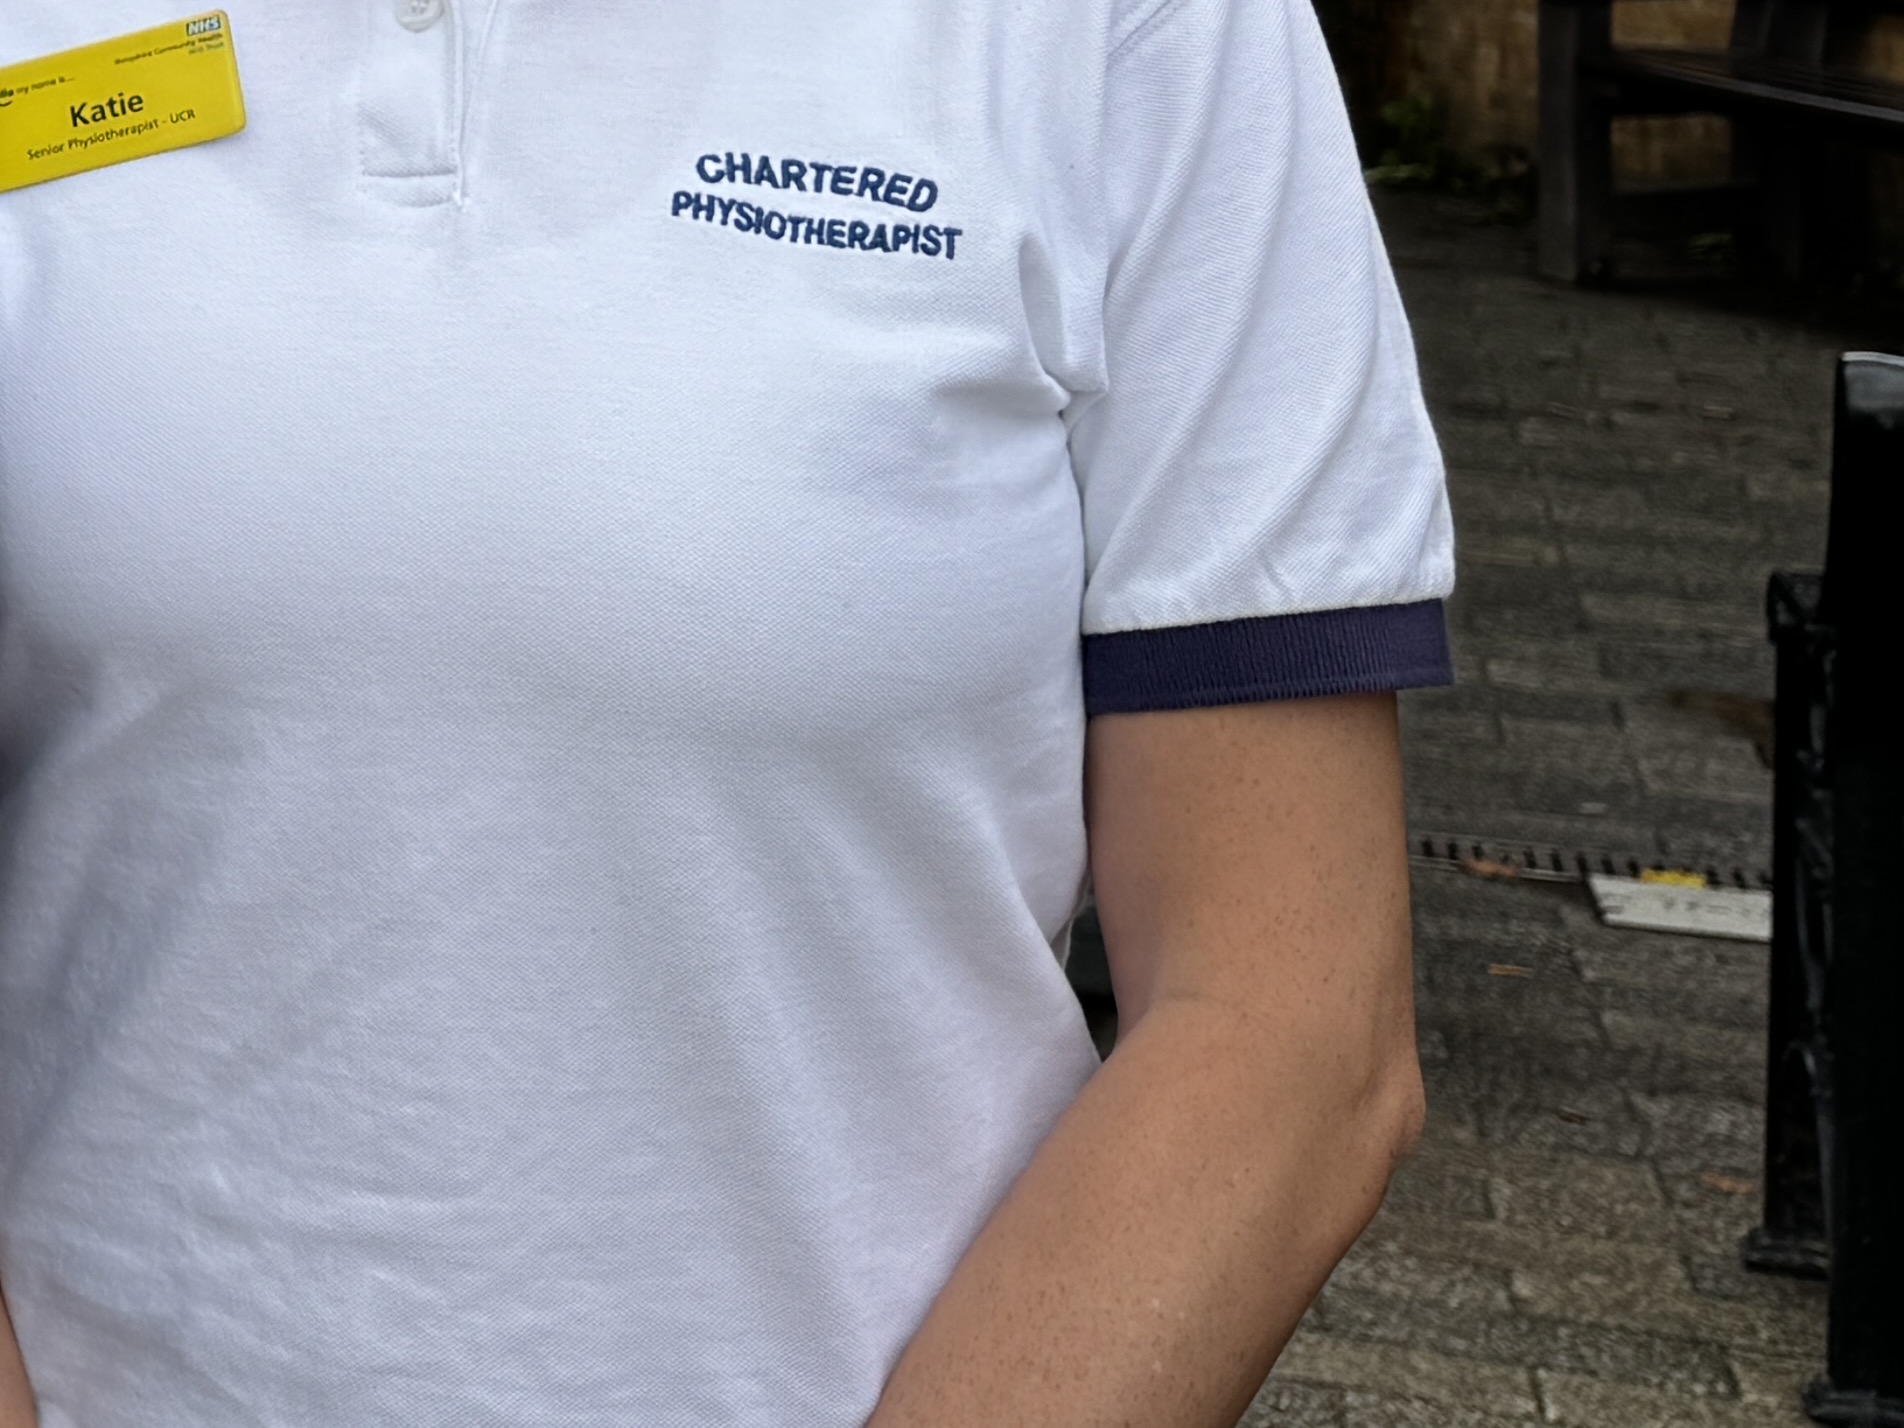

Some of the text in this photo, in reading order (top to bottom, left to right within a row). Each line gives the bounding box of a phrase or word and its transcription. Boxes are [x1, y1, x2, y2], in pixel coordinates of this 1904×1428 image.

[188, 15, 220, 35] NHS
[26, 143, 65, 160] Senior
[68, 118, 159, 150] Physiotherapist
[169, 108, 196, 125] UCR
[70, 92, 144, 127] Katie
[695, 151, 938, 213] CHARTERED
[671, 190, 963, 260] PHYSIOTHERAPIST
